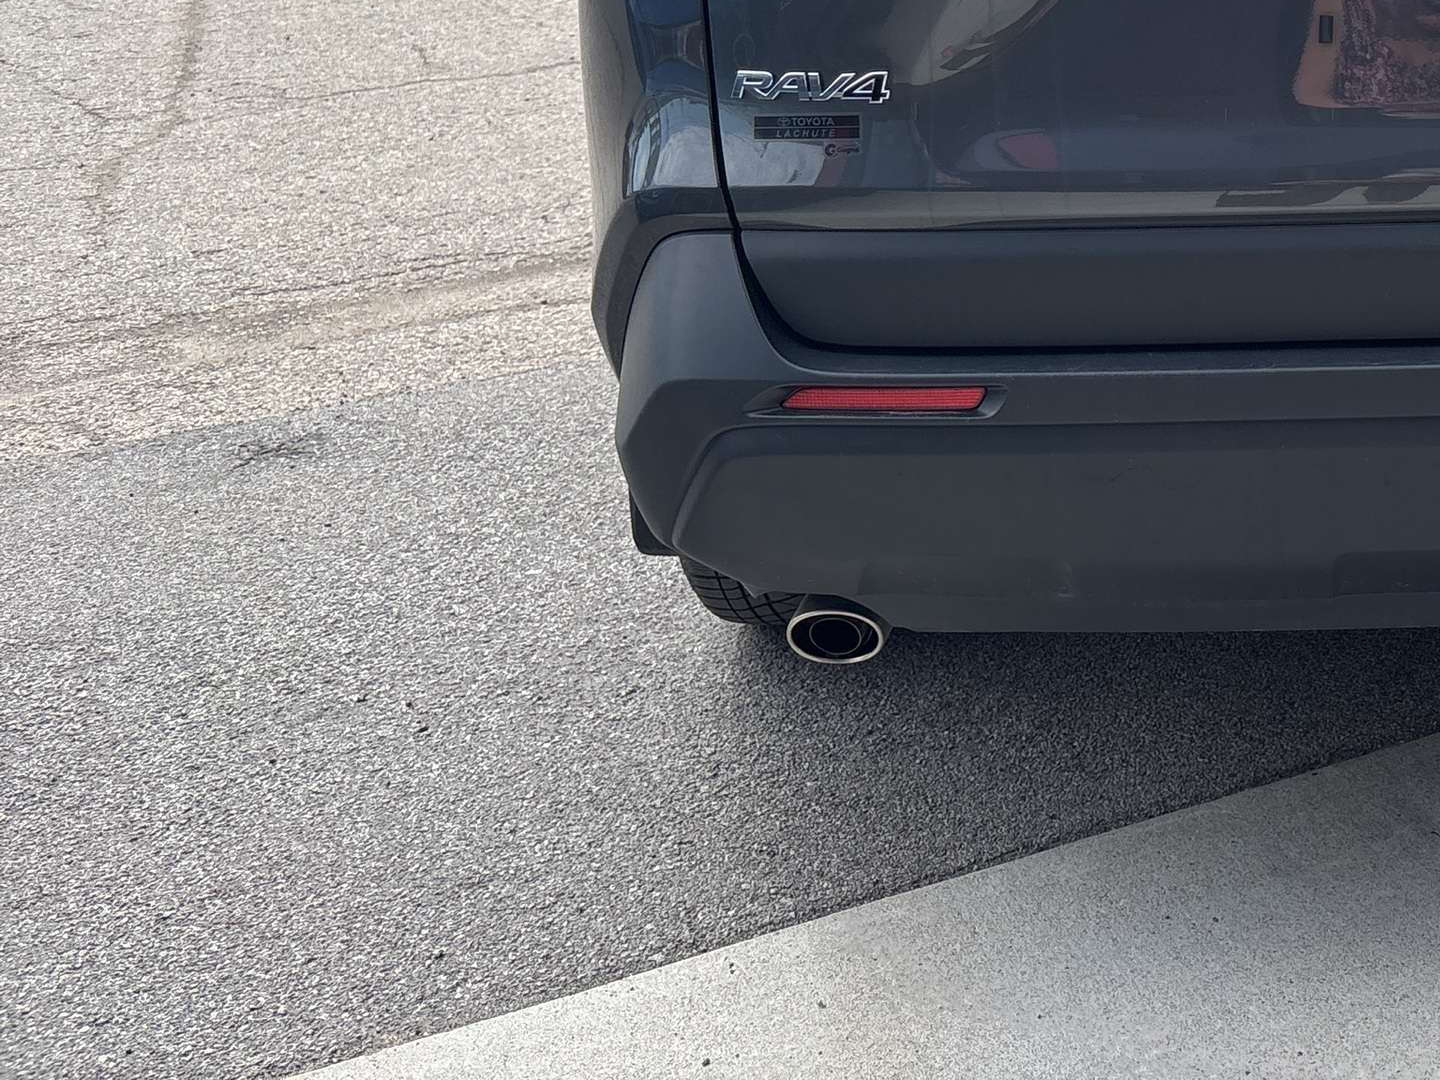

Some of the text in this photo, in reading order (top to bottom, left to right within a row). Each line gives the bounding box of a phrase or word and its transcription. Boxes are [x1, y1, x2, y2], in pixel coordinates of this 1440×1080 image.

[731, 69, 890, 104] RAV4
[792, 117, 835, 126] TOYOTA
[776, 129, 836, 138] LACHUTE
